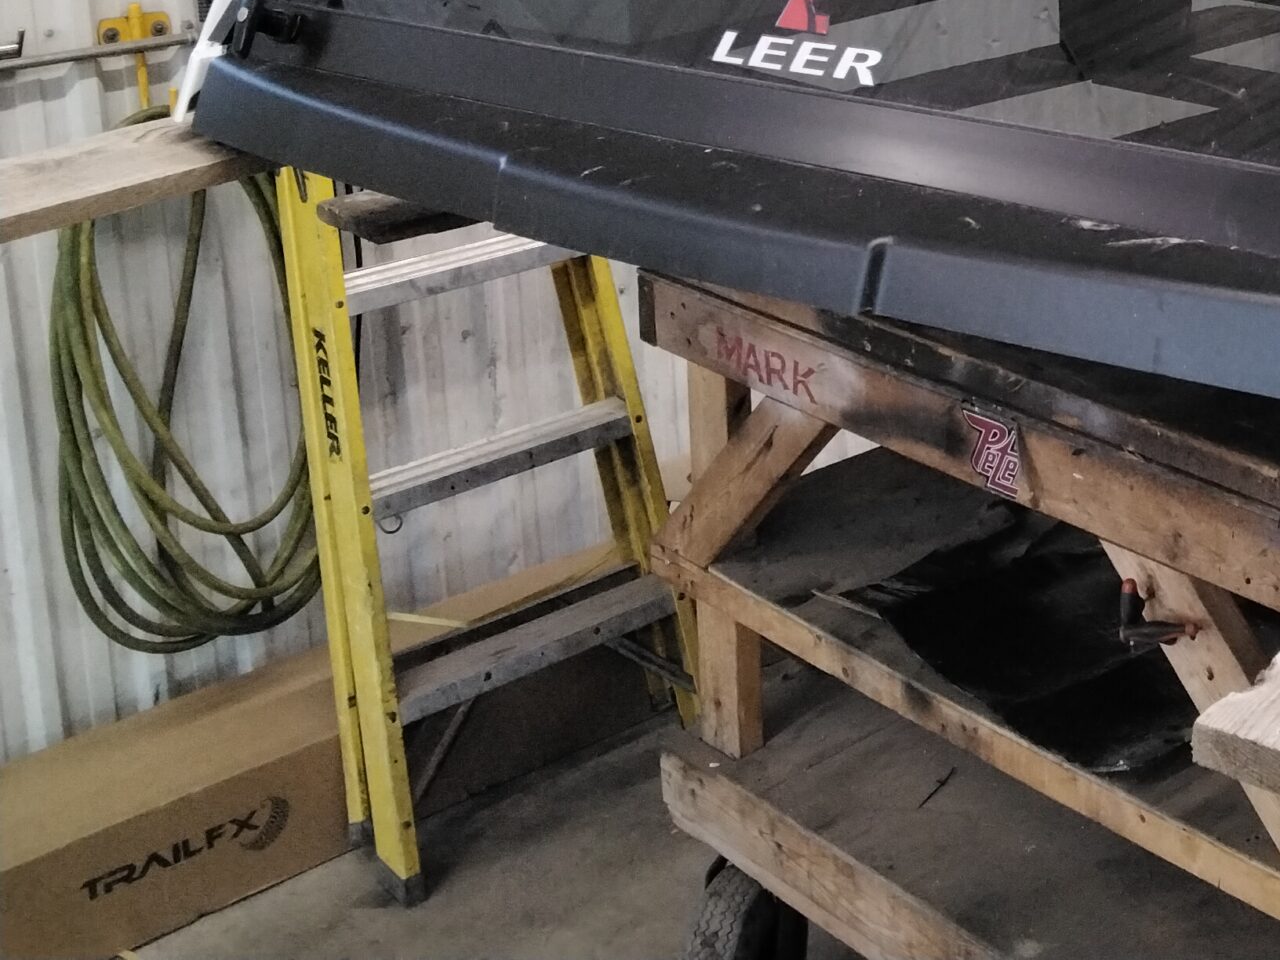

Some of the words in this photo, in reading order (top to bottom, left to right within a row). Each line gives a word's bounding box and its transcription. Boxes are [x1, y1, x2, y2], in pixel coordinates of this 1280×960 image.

[711, 28, 883, 87] LEER
[311, 327, 343, 464] KELLER
[715, 326, 819, 405] MARK
[80, 810, 260, 901] TRAILFX
